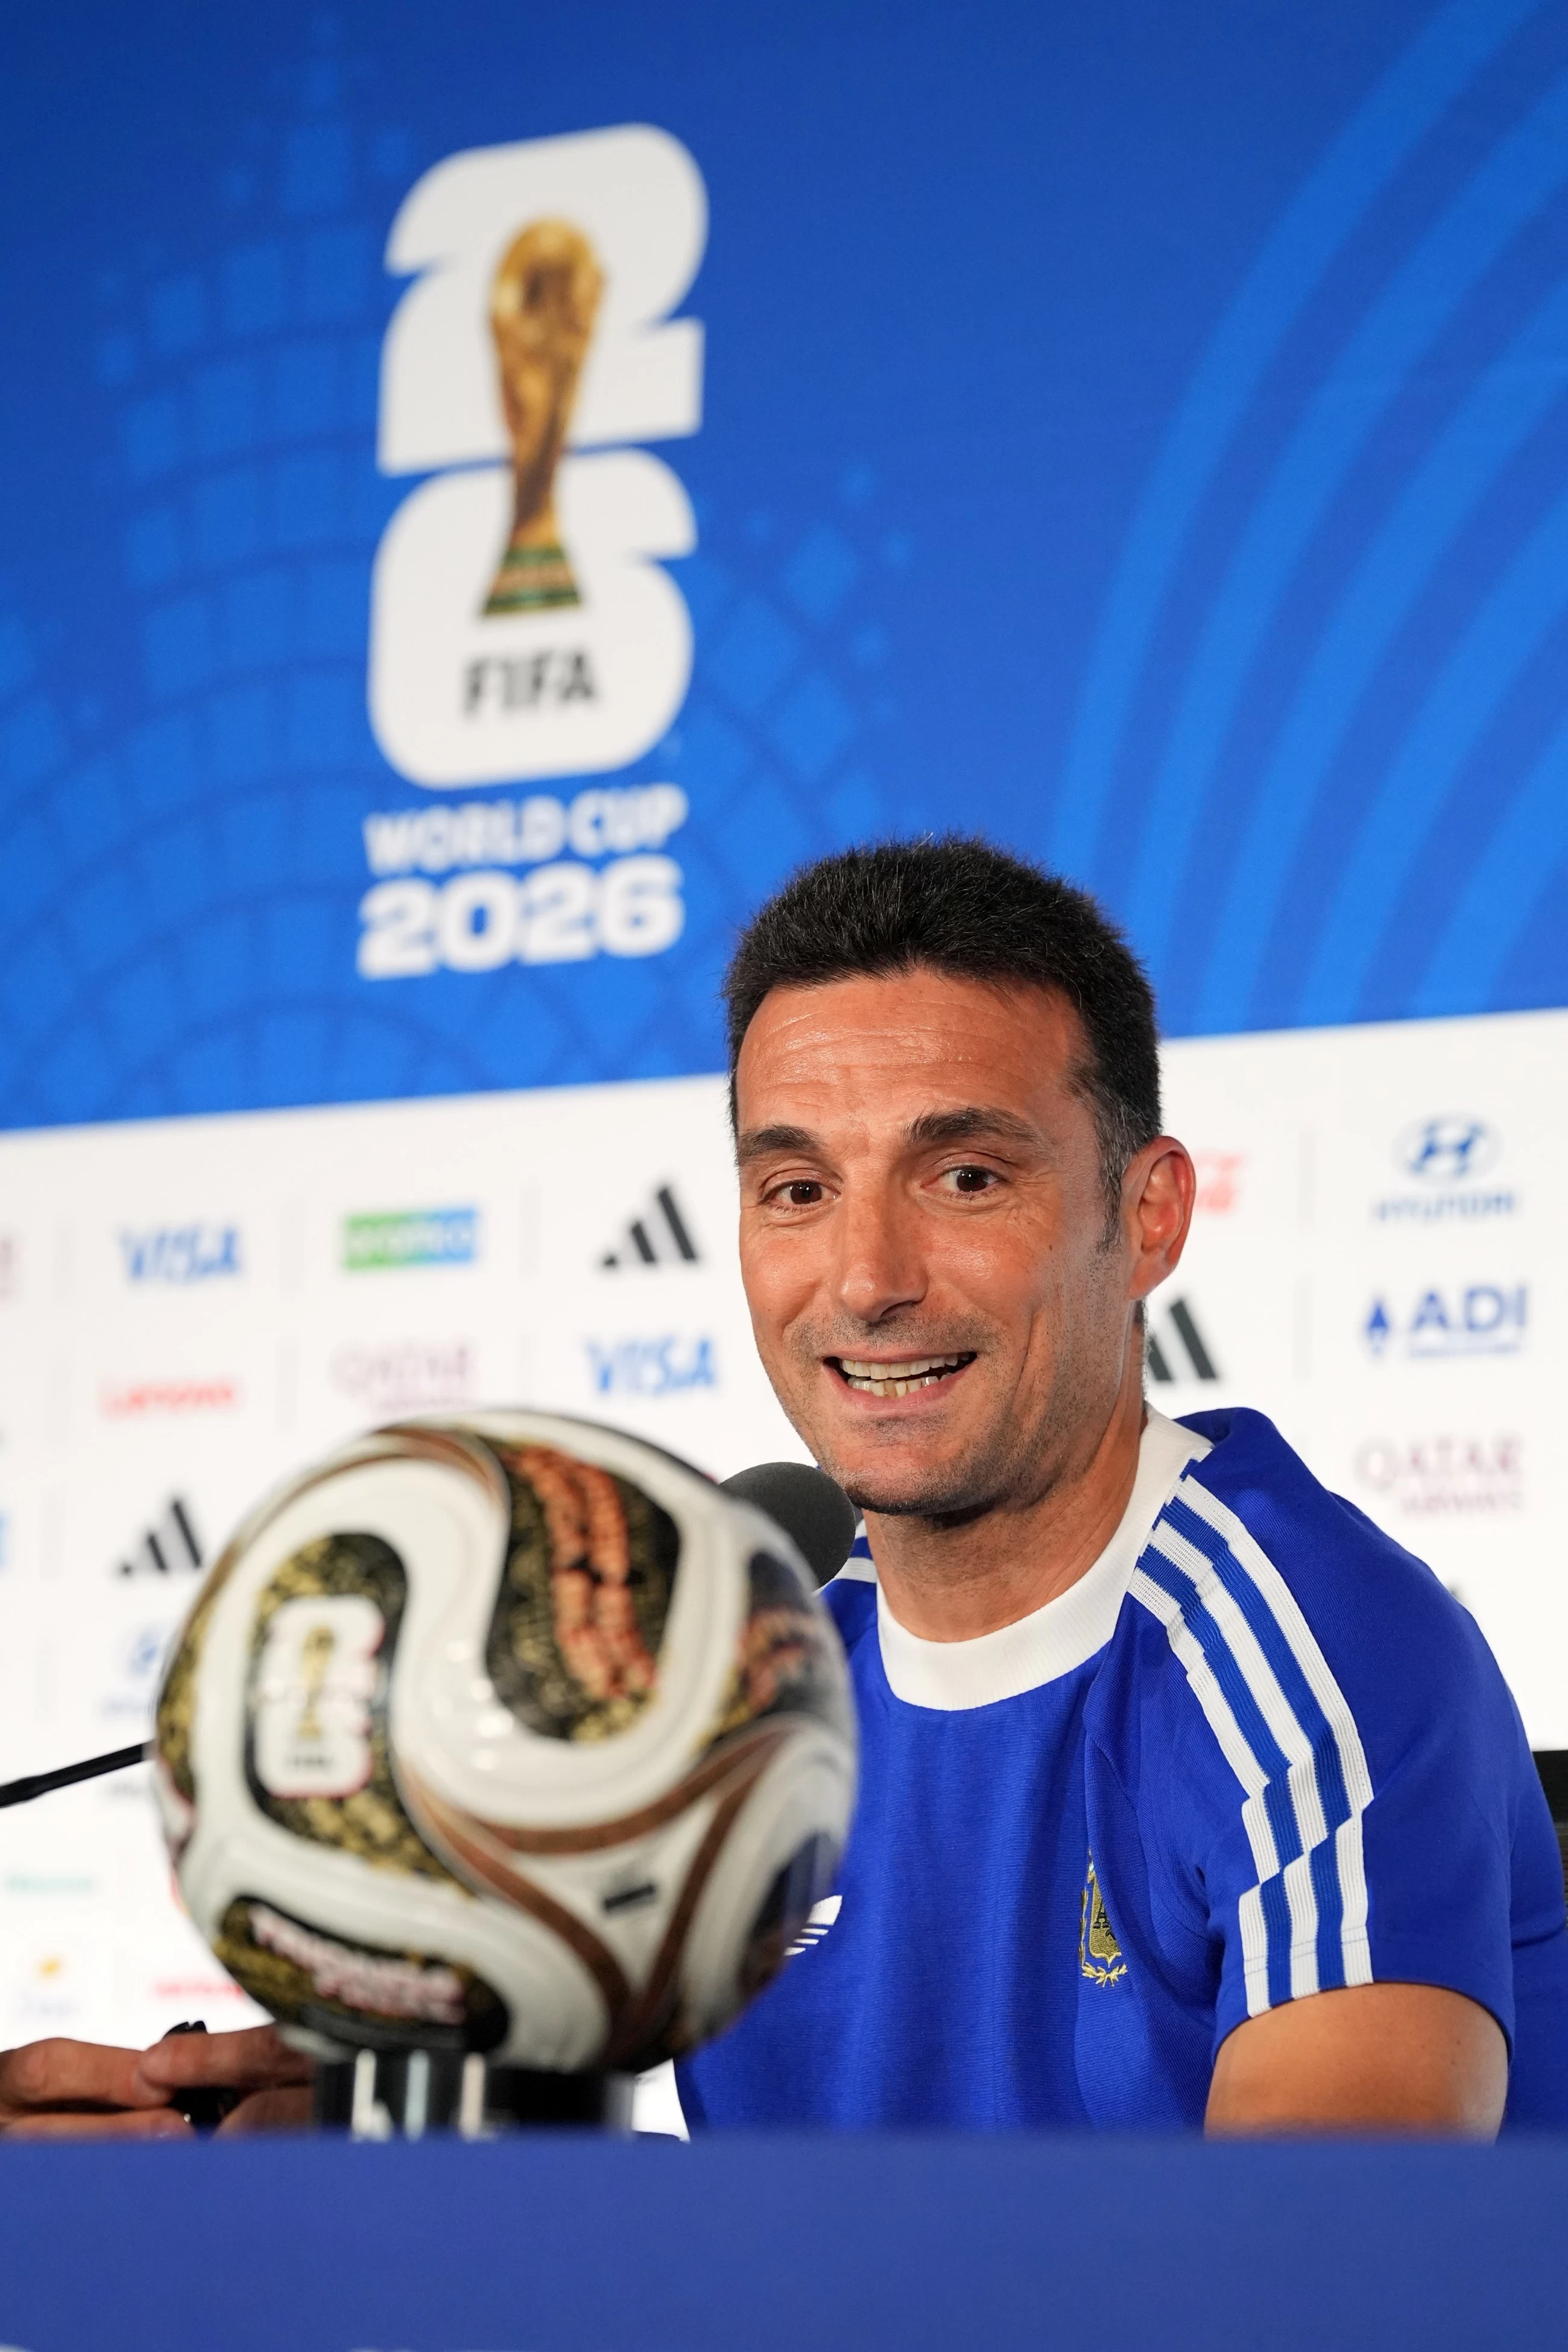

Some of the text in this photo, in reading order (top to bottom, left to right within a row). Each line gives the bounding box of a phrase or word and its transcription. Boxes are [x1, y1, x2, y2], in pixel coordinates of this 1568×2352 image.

[464, 648, 596, 716] FIFA
[364, 782, 689, 876] WORLD CUP
[357, 853, 686, 981] 2026
[119, 1224, 241, 1282] VISA
[1410, 1286, 1528, 1334] ADI
[584, 1335, 718, 1394] VISA
[1356, 1434, 1525, 1494] QATAR
